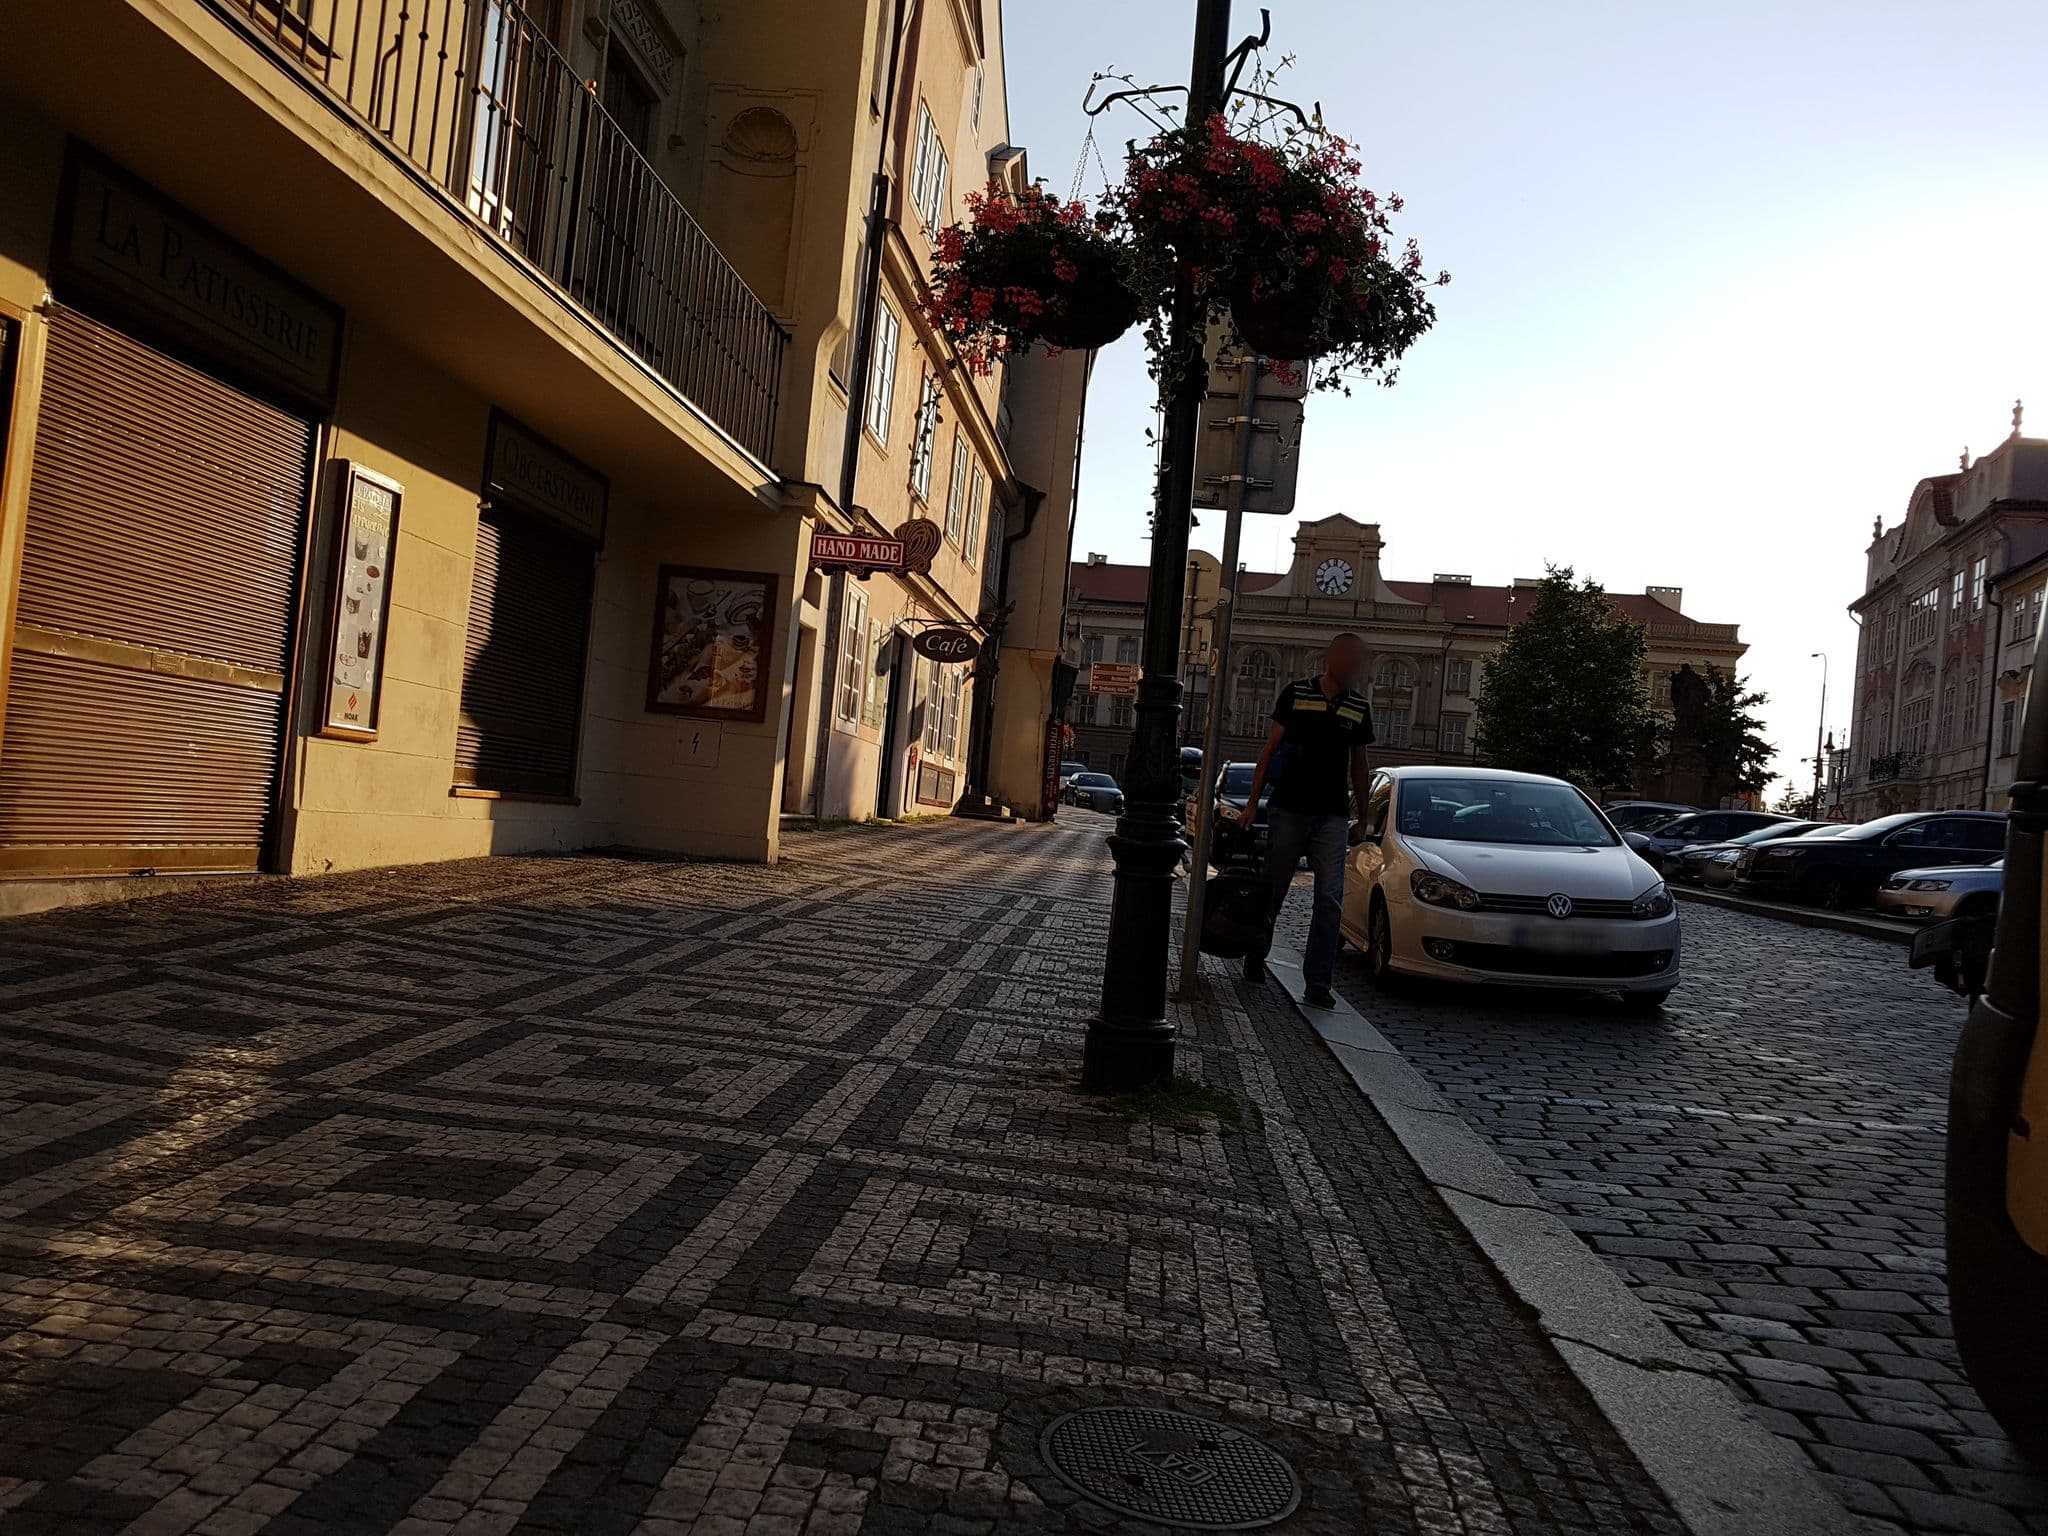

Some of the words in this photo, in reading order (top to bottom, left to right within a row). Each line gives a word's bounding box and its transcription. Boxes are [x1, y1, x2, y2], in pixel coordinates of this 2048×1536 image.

[97, 184, 141, 265] LA
[160, 221, 319, 361] PATISSERIE
[817, 540, 856, 559] HAND
[860, 545, 900, 562] MADE
[925, 635, 968, 656] Café
